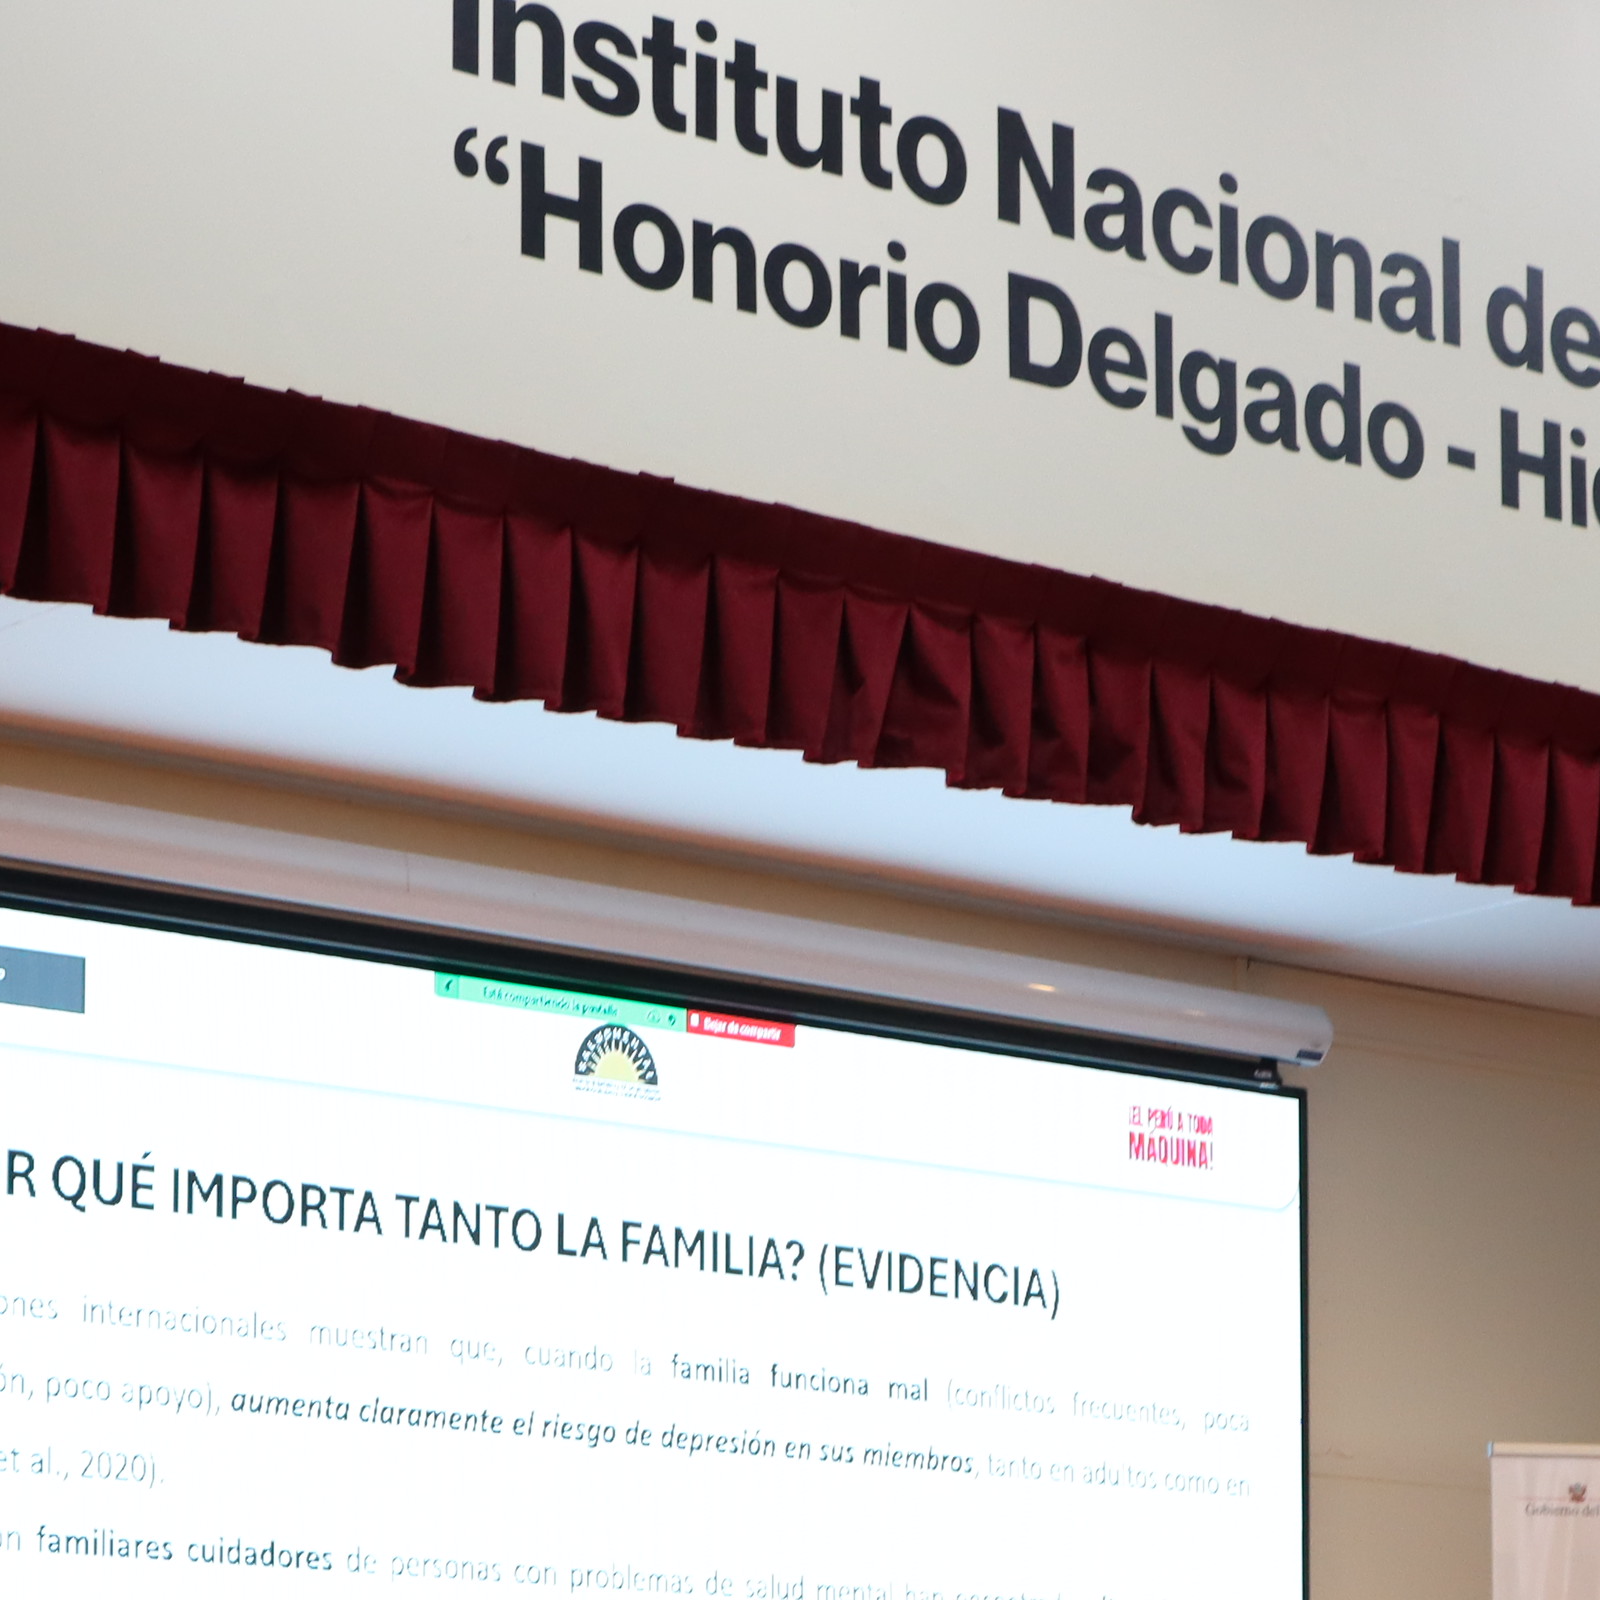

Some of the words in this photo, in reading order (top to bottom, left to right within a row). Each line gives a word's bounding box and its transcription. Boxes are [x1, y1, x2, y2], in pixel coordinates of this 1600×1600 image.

[453, 0, 967, 205] Instituto
[998, 107, 1460, 346] Nacional
[1008, 272, 1424, 479] Delgado
[50, 1148, 157, 1215] QUÉ
[171, 1165, 385, 1238] IMPORTA
[393, 1191, 544, 1254] TANTO
[555, 1210, 610, 1263] LA
[620, 1218, 807, 1284] FAMILIA?
[817, 1241, 1062, 1322] (EVIDENCIA)
[229, 1392, 352, 1423] aumenta
[357, 1395, 505, 1436] claramente
[511, 1409, 536, 1438] el
[540, 1411, 618, 1450] riesgo
[624, 1417, 654, 1448] de
[660, 1421, 777, 1459] depresión
[783, 1439, 813, 1462] en
[817, 1442, 857, 1465] sus
[861, 1440, 981, 1481] miembros,
[669, 1351, 751, 1387] familia
[769, 1360, 870, 1398] funciona
[887, 1375, 929, 1403] mal
[35, 1522, 175, 1562] familiares
[186, 1535, 335, 1573] cuidadores
